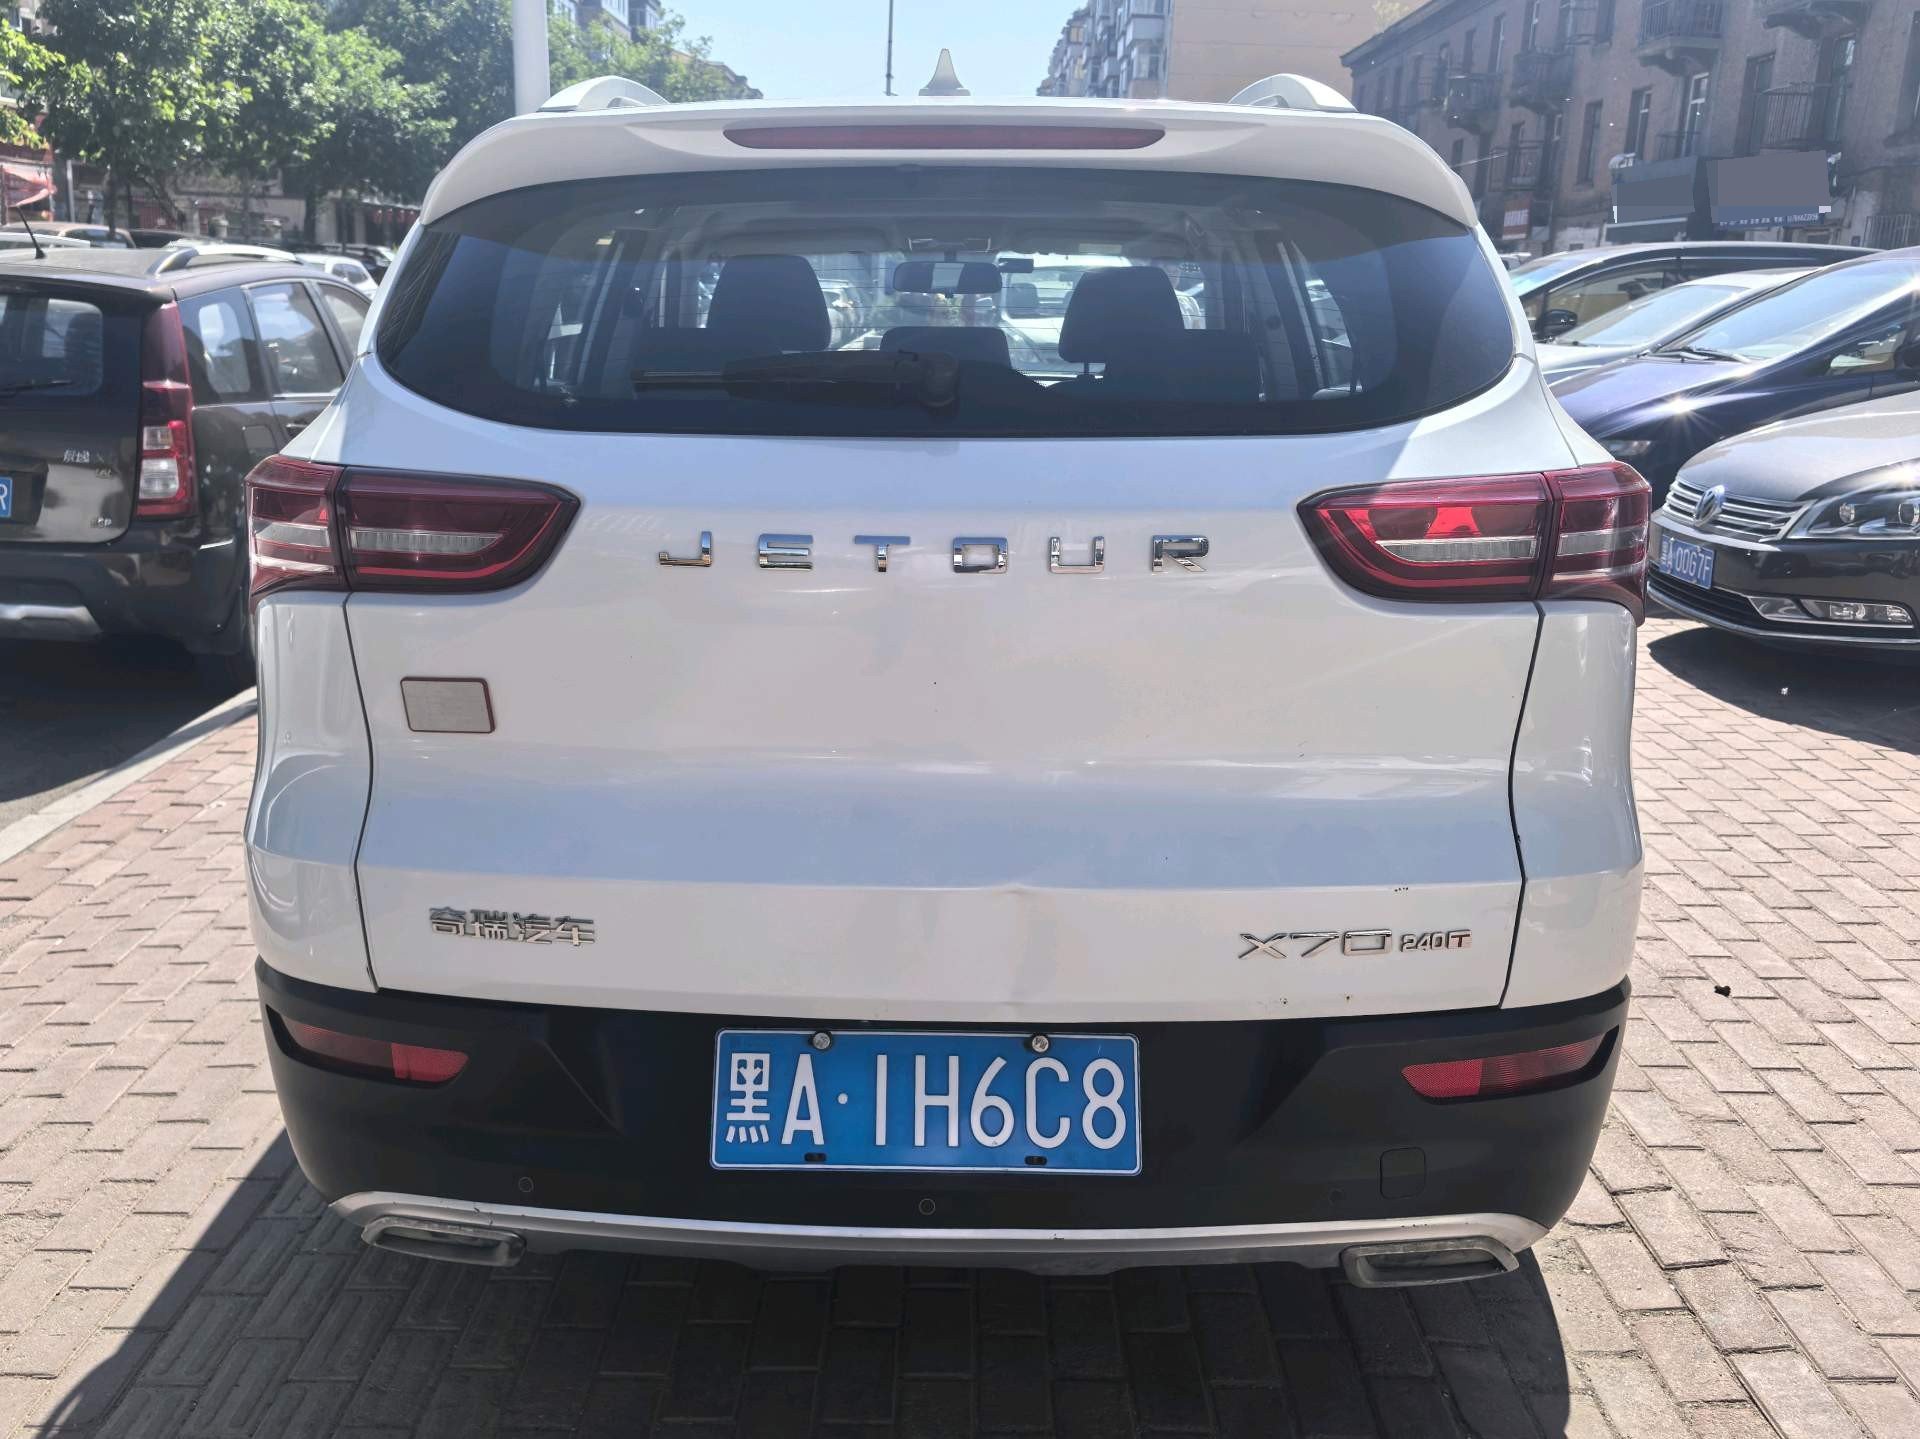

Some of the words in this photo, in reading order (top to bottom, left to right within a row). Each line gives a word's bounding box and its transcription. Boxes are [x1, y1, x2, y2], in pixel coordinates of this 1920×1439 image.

[658, 530, 1209, 574] JETOUR
[428, 906, 596, 947] 奇瑞汽车
[1238, 929, 1392, 959] X70
[1400, 929, 1472, 953] 240T
